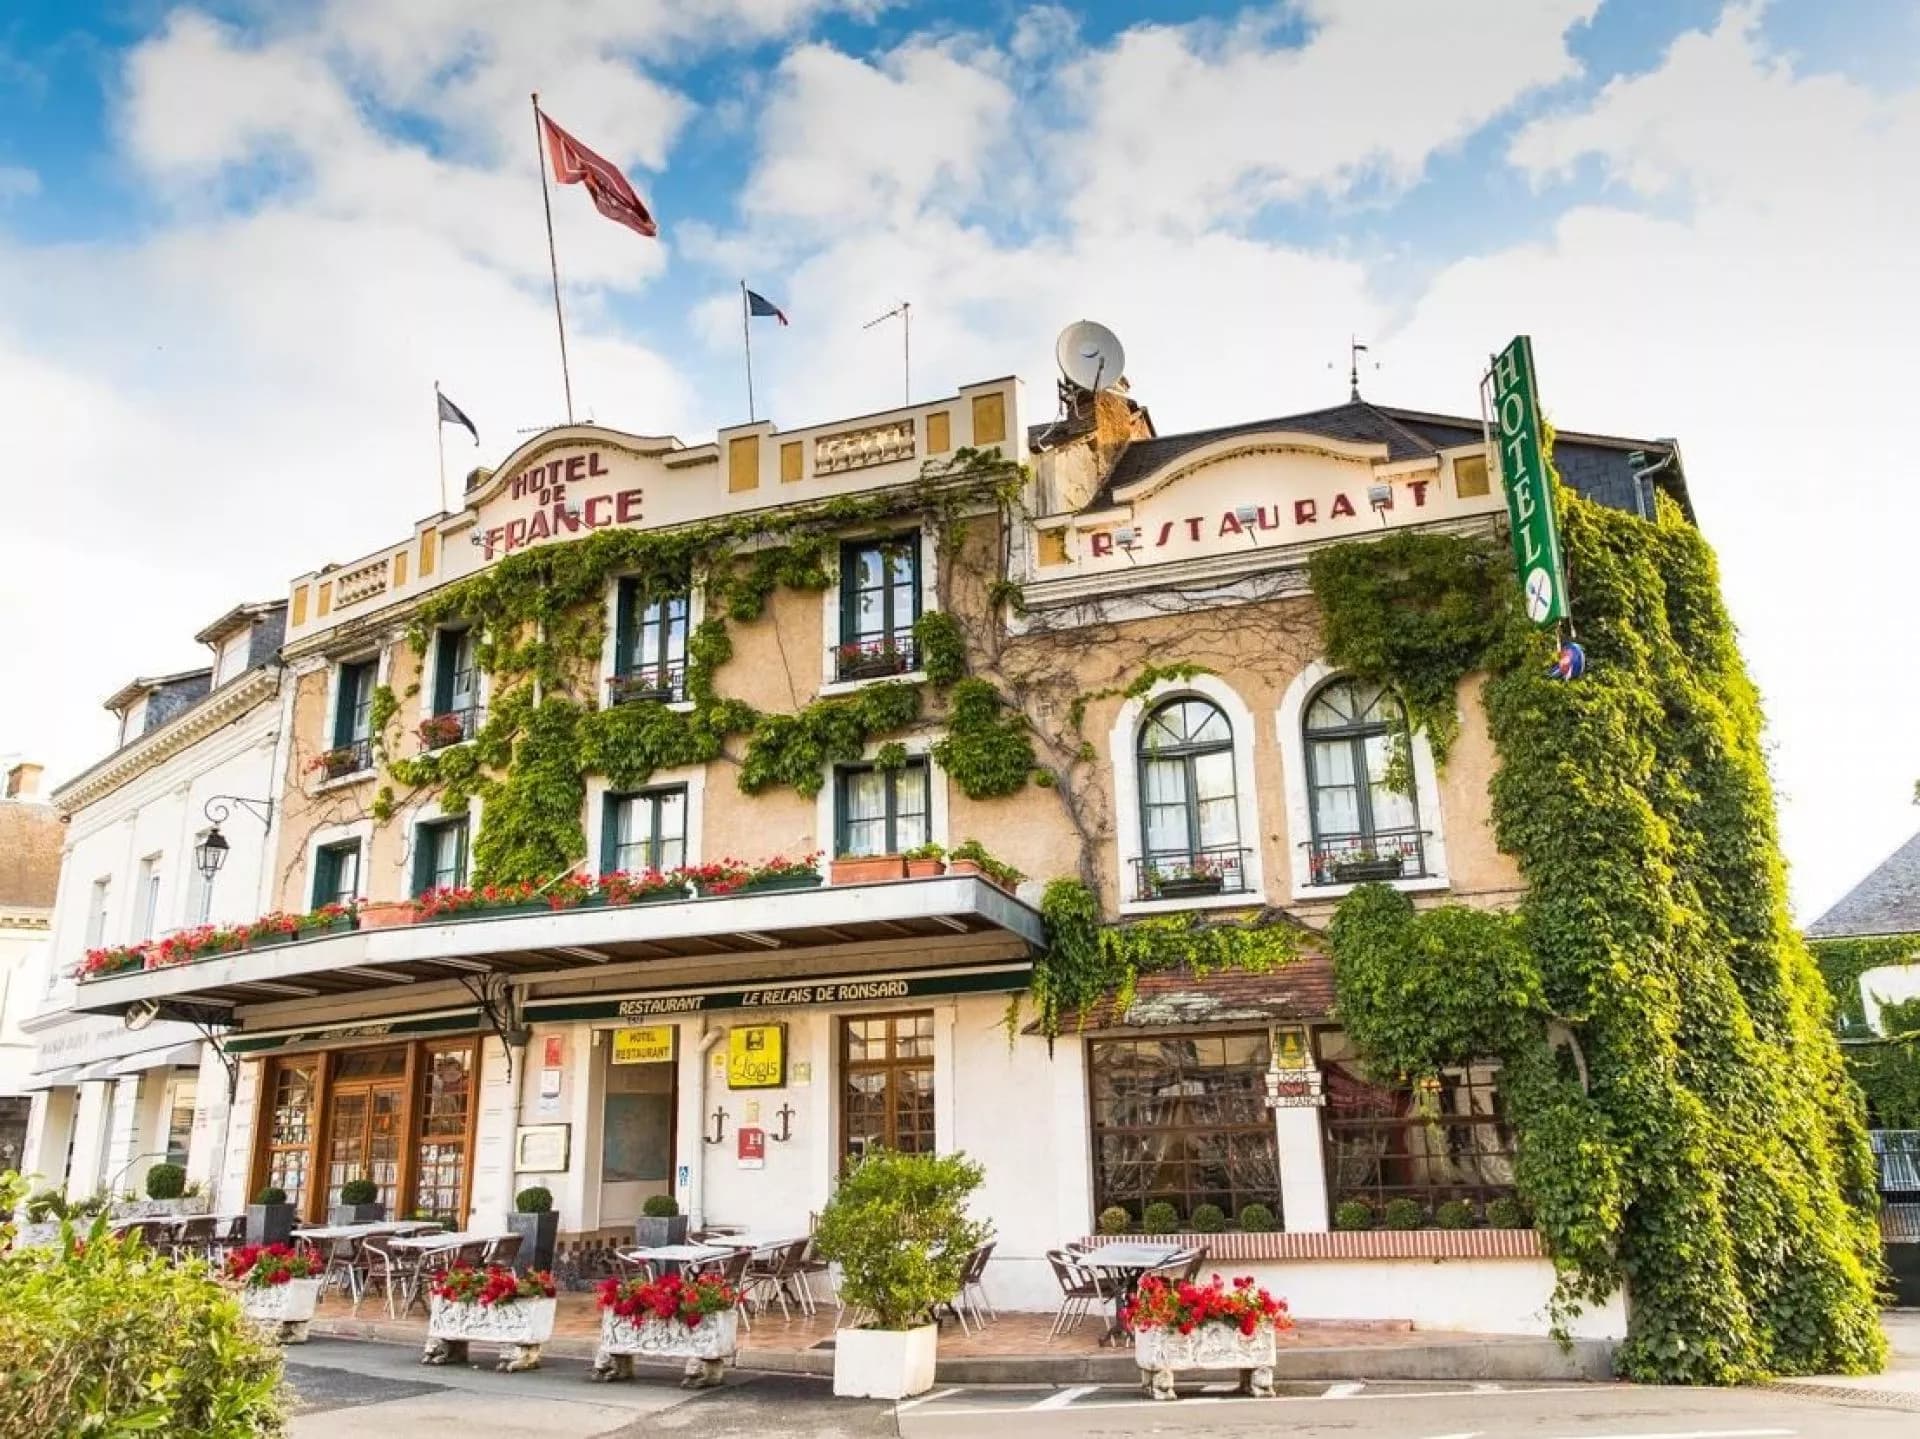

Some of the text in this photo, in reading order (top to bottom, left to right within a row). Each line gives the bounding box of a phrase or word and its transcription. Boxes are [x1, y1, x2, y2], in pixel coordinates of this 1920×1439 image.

[511, 452, 608, 500] HOTEL
[1494, 345, 1541, 567] HOTEL
[539, 484, 566, 506] DE
[484, 488, 643, 561] FRANCE
[619, 980, 909, 1015] RESTAURANT LE RELAIS DE RONSARD
[615, 1047, 669, 1059] RESTAURANT
